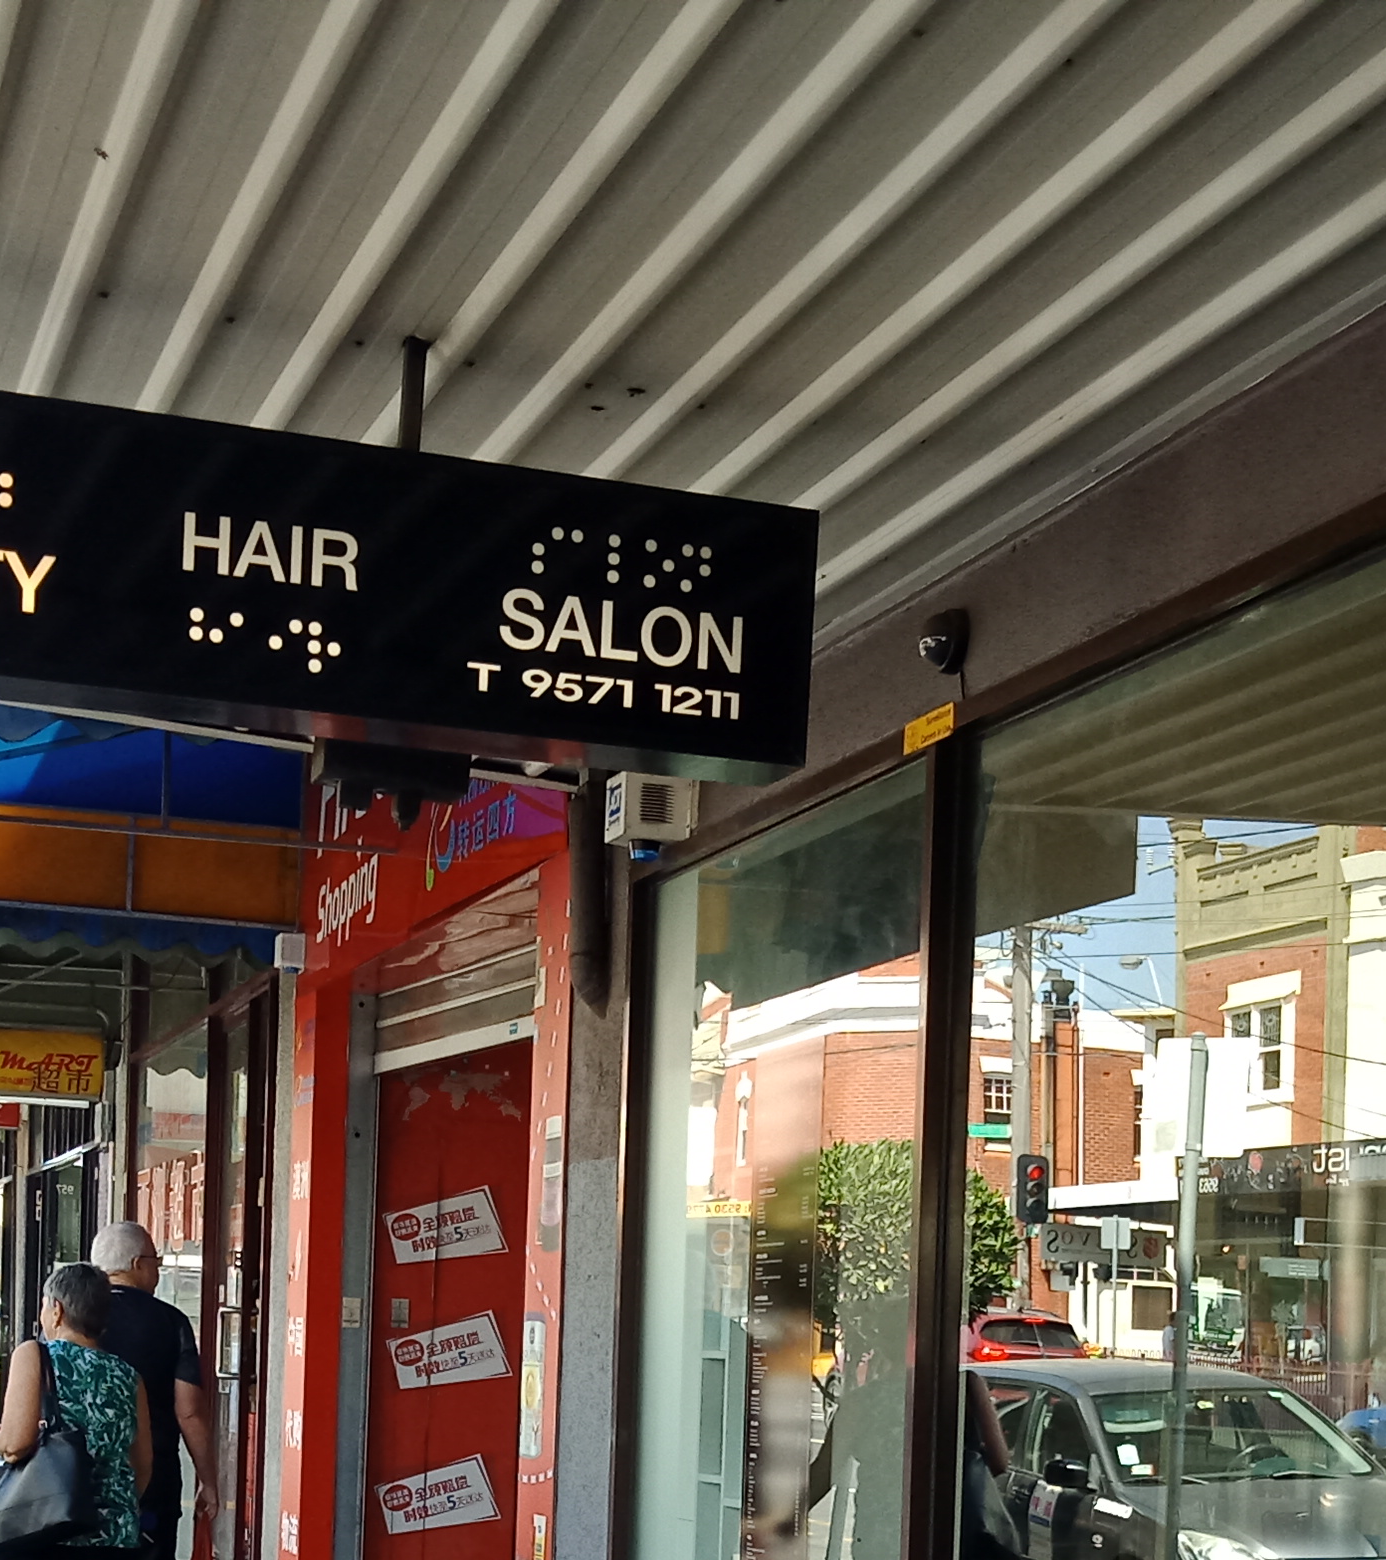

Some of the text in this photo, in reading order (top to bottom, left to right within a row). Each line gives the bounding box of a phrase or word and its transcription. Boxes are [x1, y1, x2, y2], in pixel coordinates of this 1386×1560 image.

[181, 510, 360, 592] HAIR
[498, 586, 745, 675] SALON
[467, 661, 740, 721] T 9571 1211
[315, 853, 380, 946] Shopping
